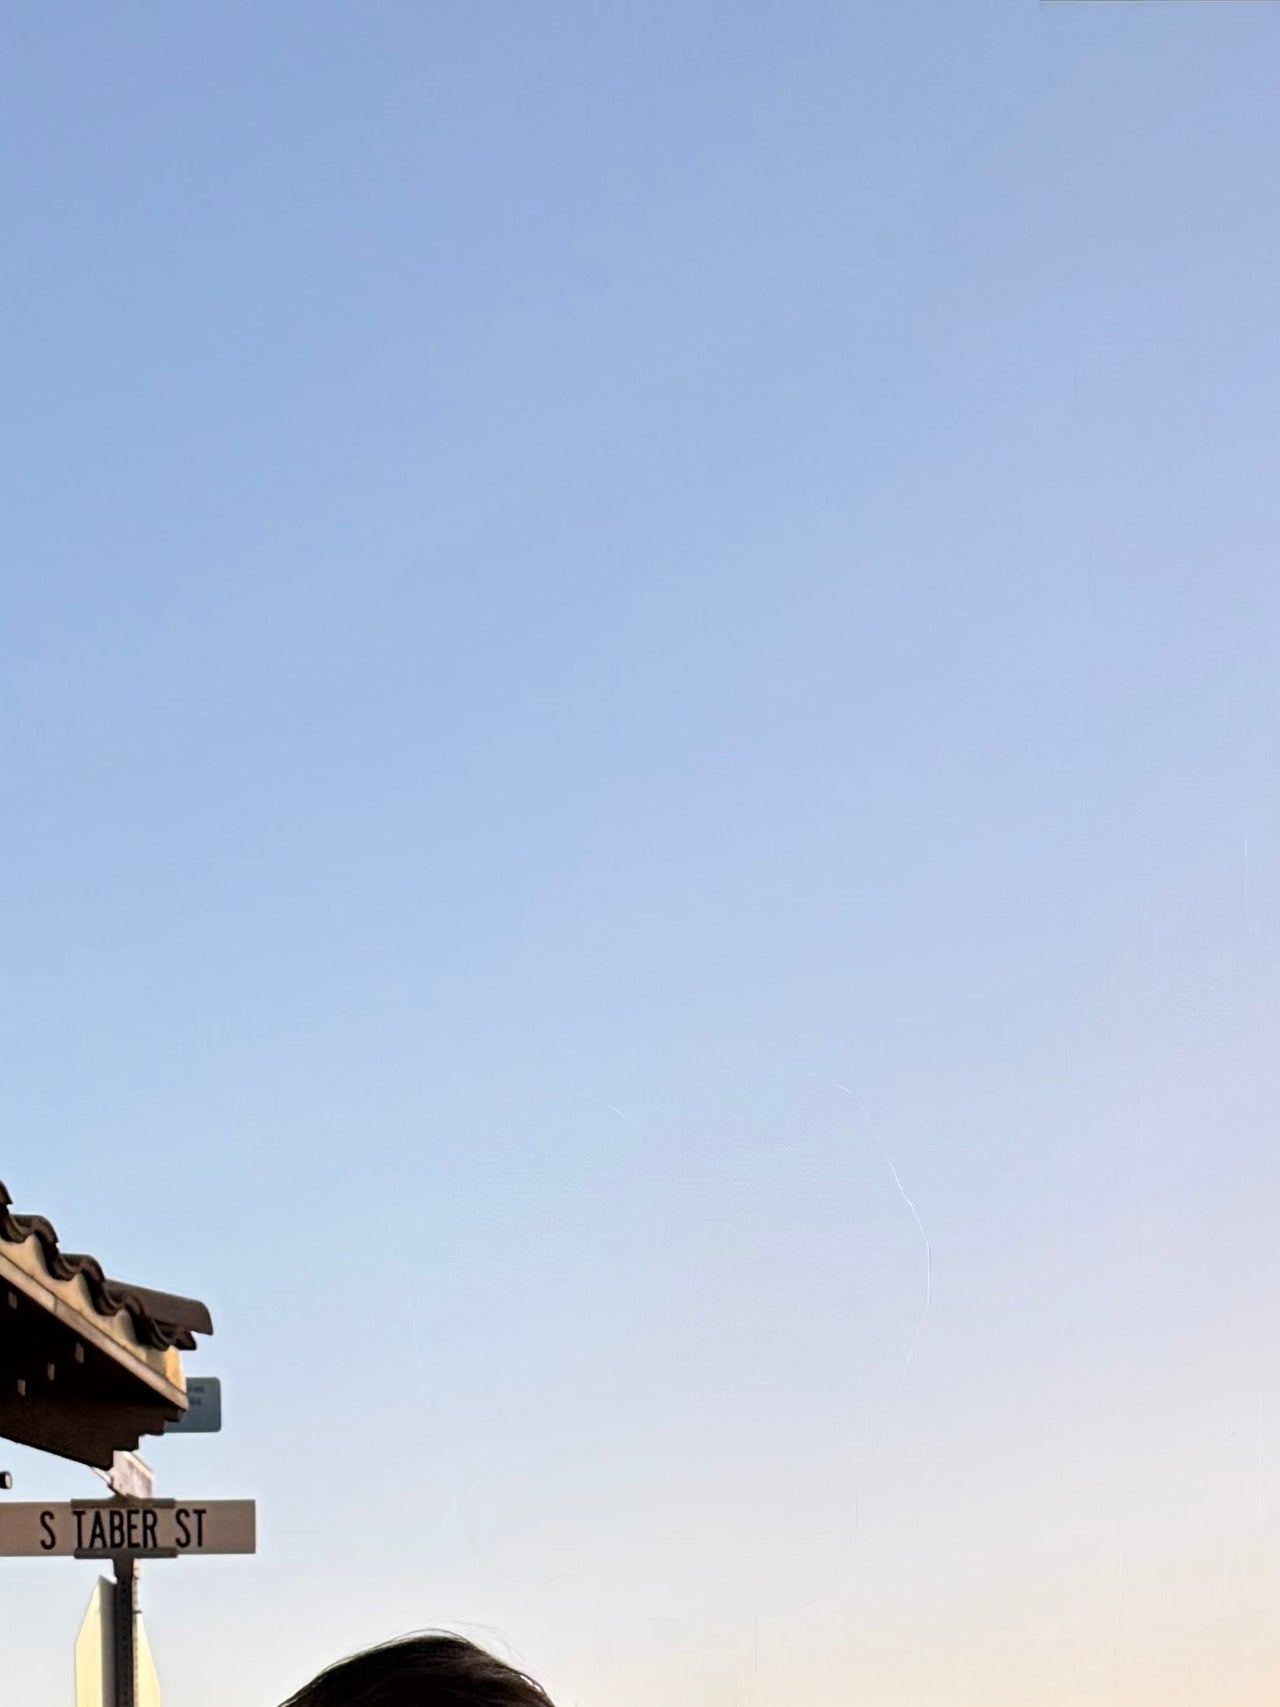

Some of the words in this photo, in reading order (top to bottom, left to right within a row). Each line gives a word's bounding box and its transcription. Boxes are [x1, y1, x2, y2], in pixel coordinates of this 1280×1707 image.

[40, 1511, 56, 1550] S
[73, 1509, 158, 1549] TABER
[175, 1508, 207, 1548] ST
